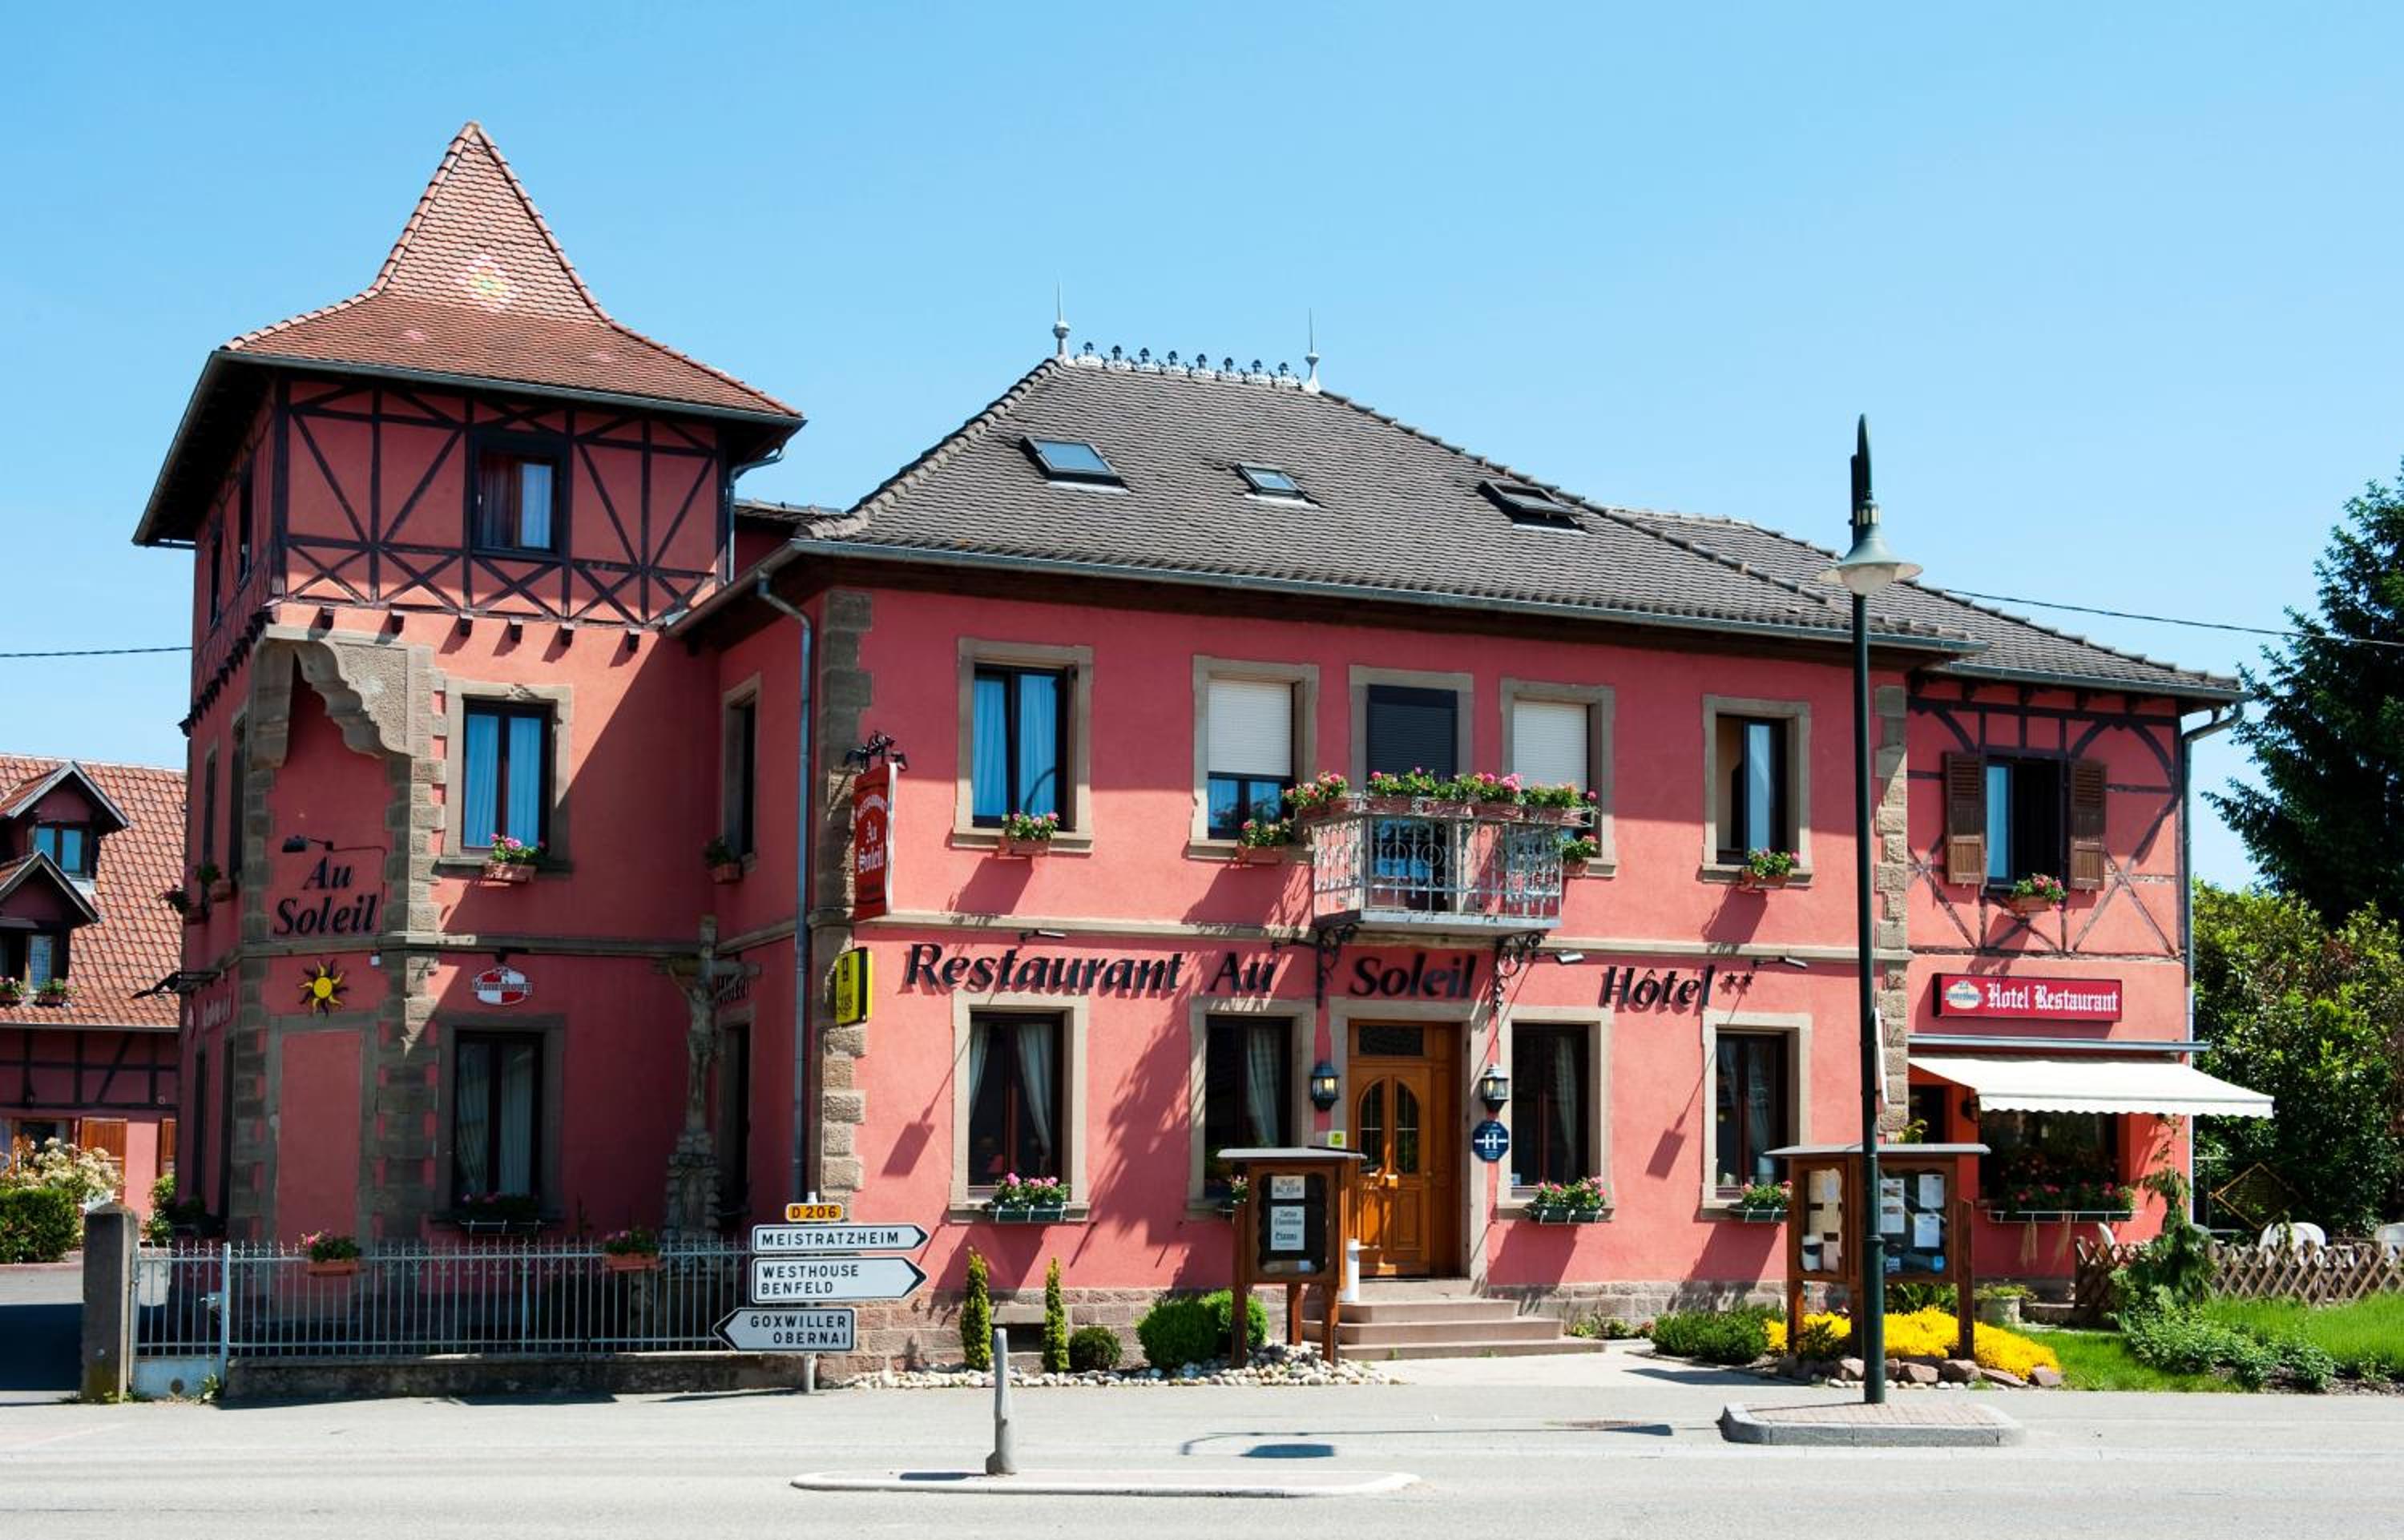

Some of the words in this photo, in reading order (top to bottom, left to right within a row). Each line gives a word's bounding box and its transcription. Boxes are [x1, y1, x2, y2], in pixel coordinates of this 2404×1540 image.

[858, 841, 884, 874] Soleil
[301, 856, 352, 890] Au
[273, 893, 377, 935] Soleil
[907, 942, 1185, 994] Restaurant
[1208, 950, 1277, 994] Au
[1348, 953, 1478, 999] Soleil
[1601, 964, 1716, 1008] Hôtel
[1987, 982, 2030, 1010] Hotel
[2034, 984, 2119, 1013] Restaurant
[793, 1206, 800, 1219] D
[805, 1205, 837, 1219] 206
[761, 1231, 899, 1246] MEISTRATZHEIM
[762, 1264, 859, 1279] WESTHOUSE
[761, 1282, 833, 1295] BENFELD
[750, 1315, 846, 1328] GOXWILLER
[773, 1332, 846, 1344] OBERNAI
